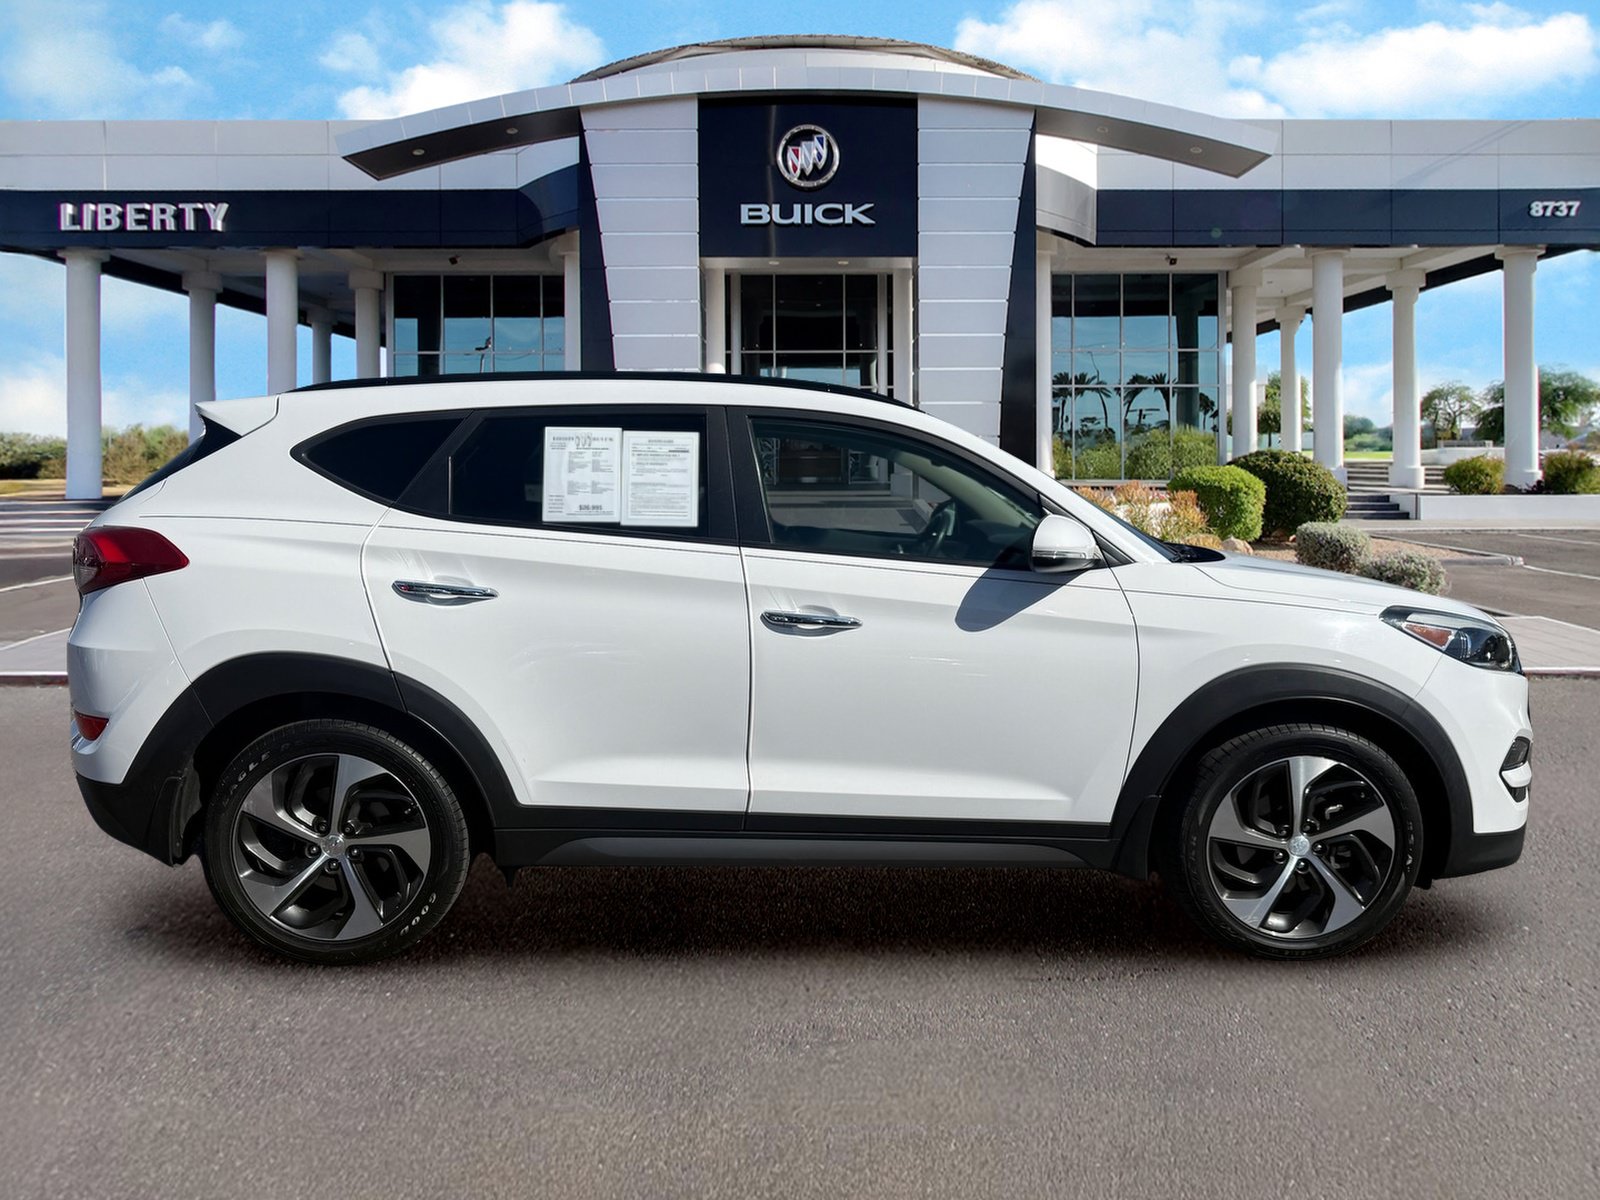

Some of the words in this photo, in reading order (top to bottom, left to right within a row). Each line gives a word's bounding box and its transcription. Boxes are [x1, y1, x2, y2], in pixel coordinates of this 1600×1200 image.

[58, 202, 229, 232] LIBERTY
[740, 203, 876, 225] BUICK
[1529, 200, 1581, 217] 8737
